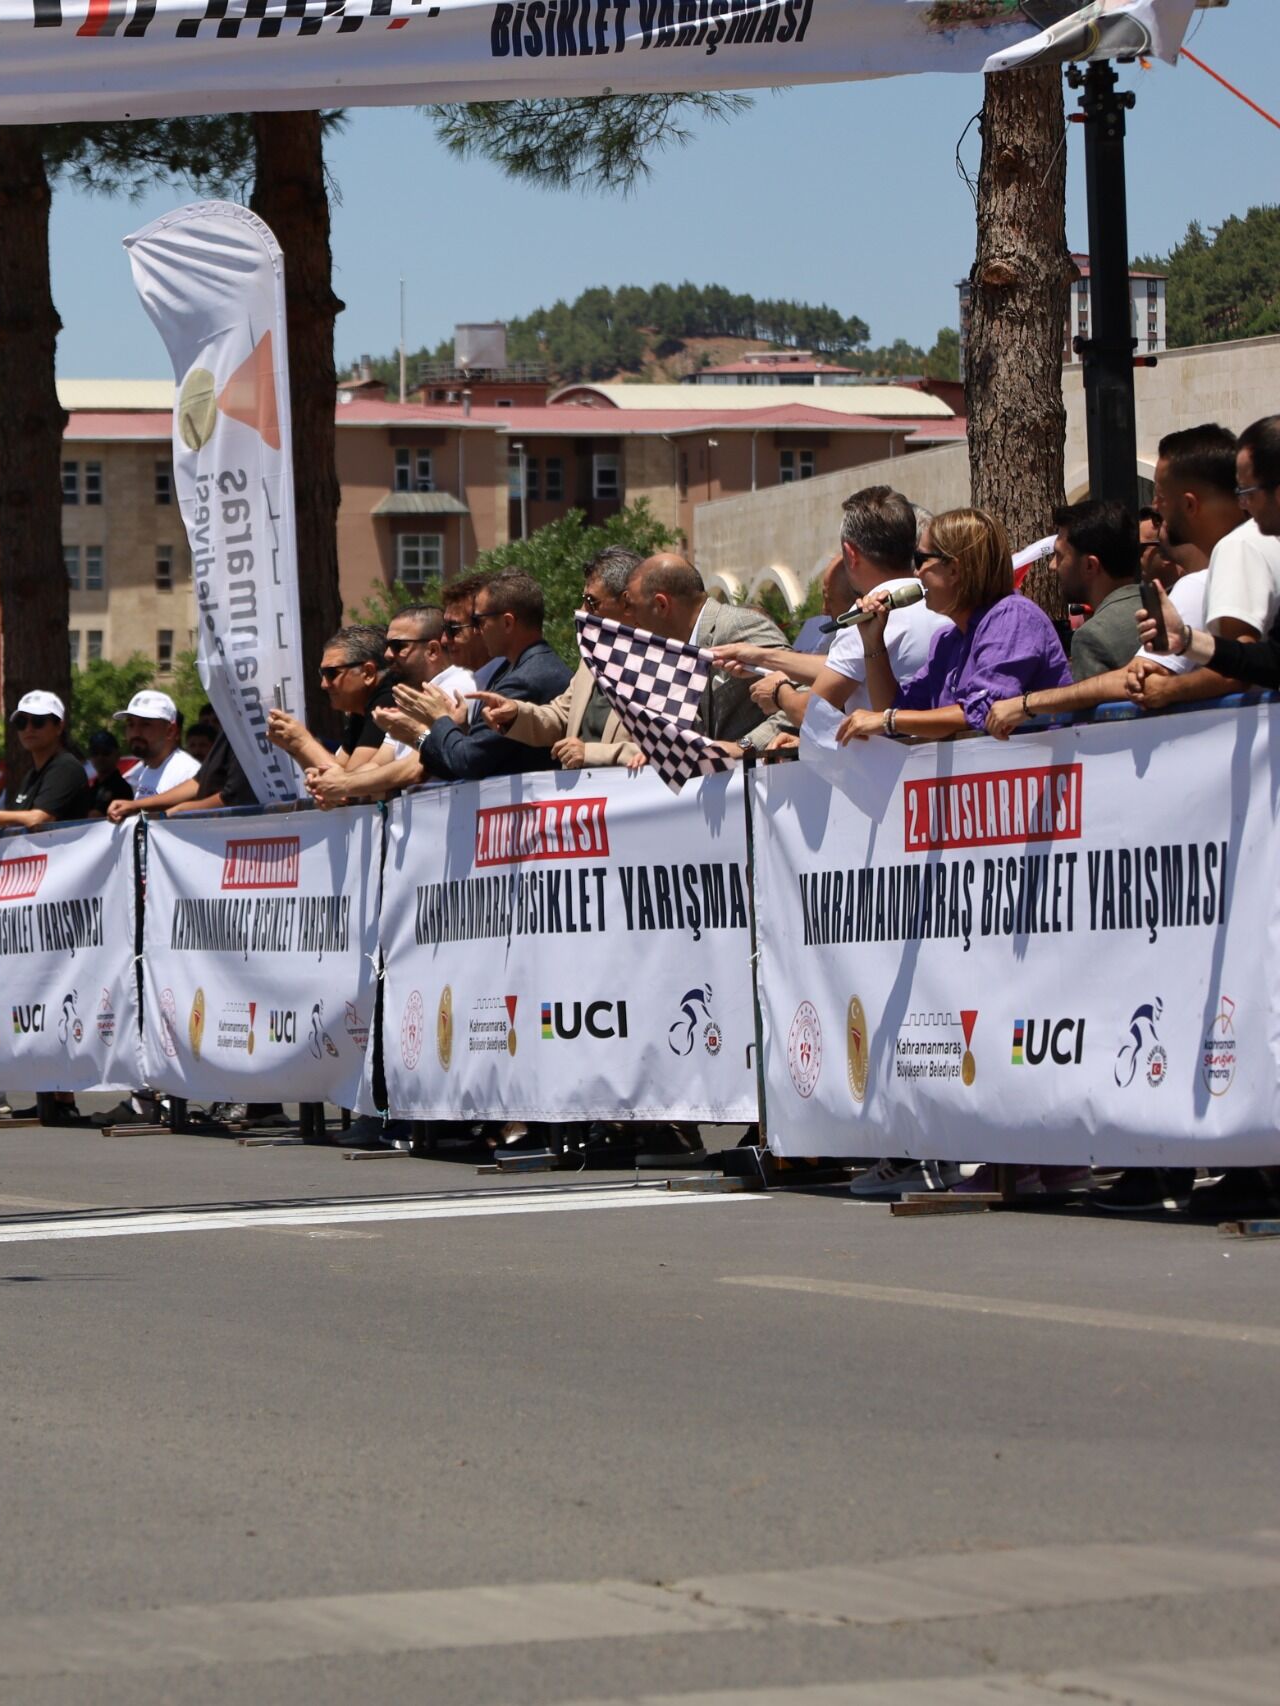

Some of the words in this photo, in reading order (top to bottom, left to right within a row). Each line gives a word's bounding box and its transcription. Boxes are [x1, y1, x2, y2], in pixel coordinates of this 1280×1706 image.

[491, 1, 629, 57] BİSİKLET
[639, 0, 814, 55] YARIŞMASI
[909, 773, 1077, 844] 2.ULUSLARARASI
[517, 867, 607, 935] BİSİKLET
[619, 863, 749, 941] YARIŞMA
[799, 860, 974, 952] KAHRAMANMARAŞ
[981, 852, 1077, 936] BİSİKLET
[1087, 841, 1227, 944] YARIŞMASI
[19, 1004, 46, 1033] UCI
[275, 1011, 296, 1043] UCI
[554, 1001, 628, 1040] UCI
[896, 1038, 962, 1060] Kahramanmaraş
[1025, 1018, 1085, 1065] UCI
[897, 1060, 928, 1083] Büyükşehir
[929, 1060, 962, 1081] Belediyesi
